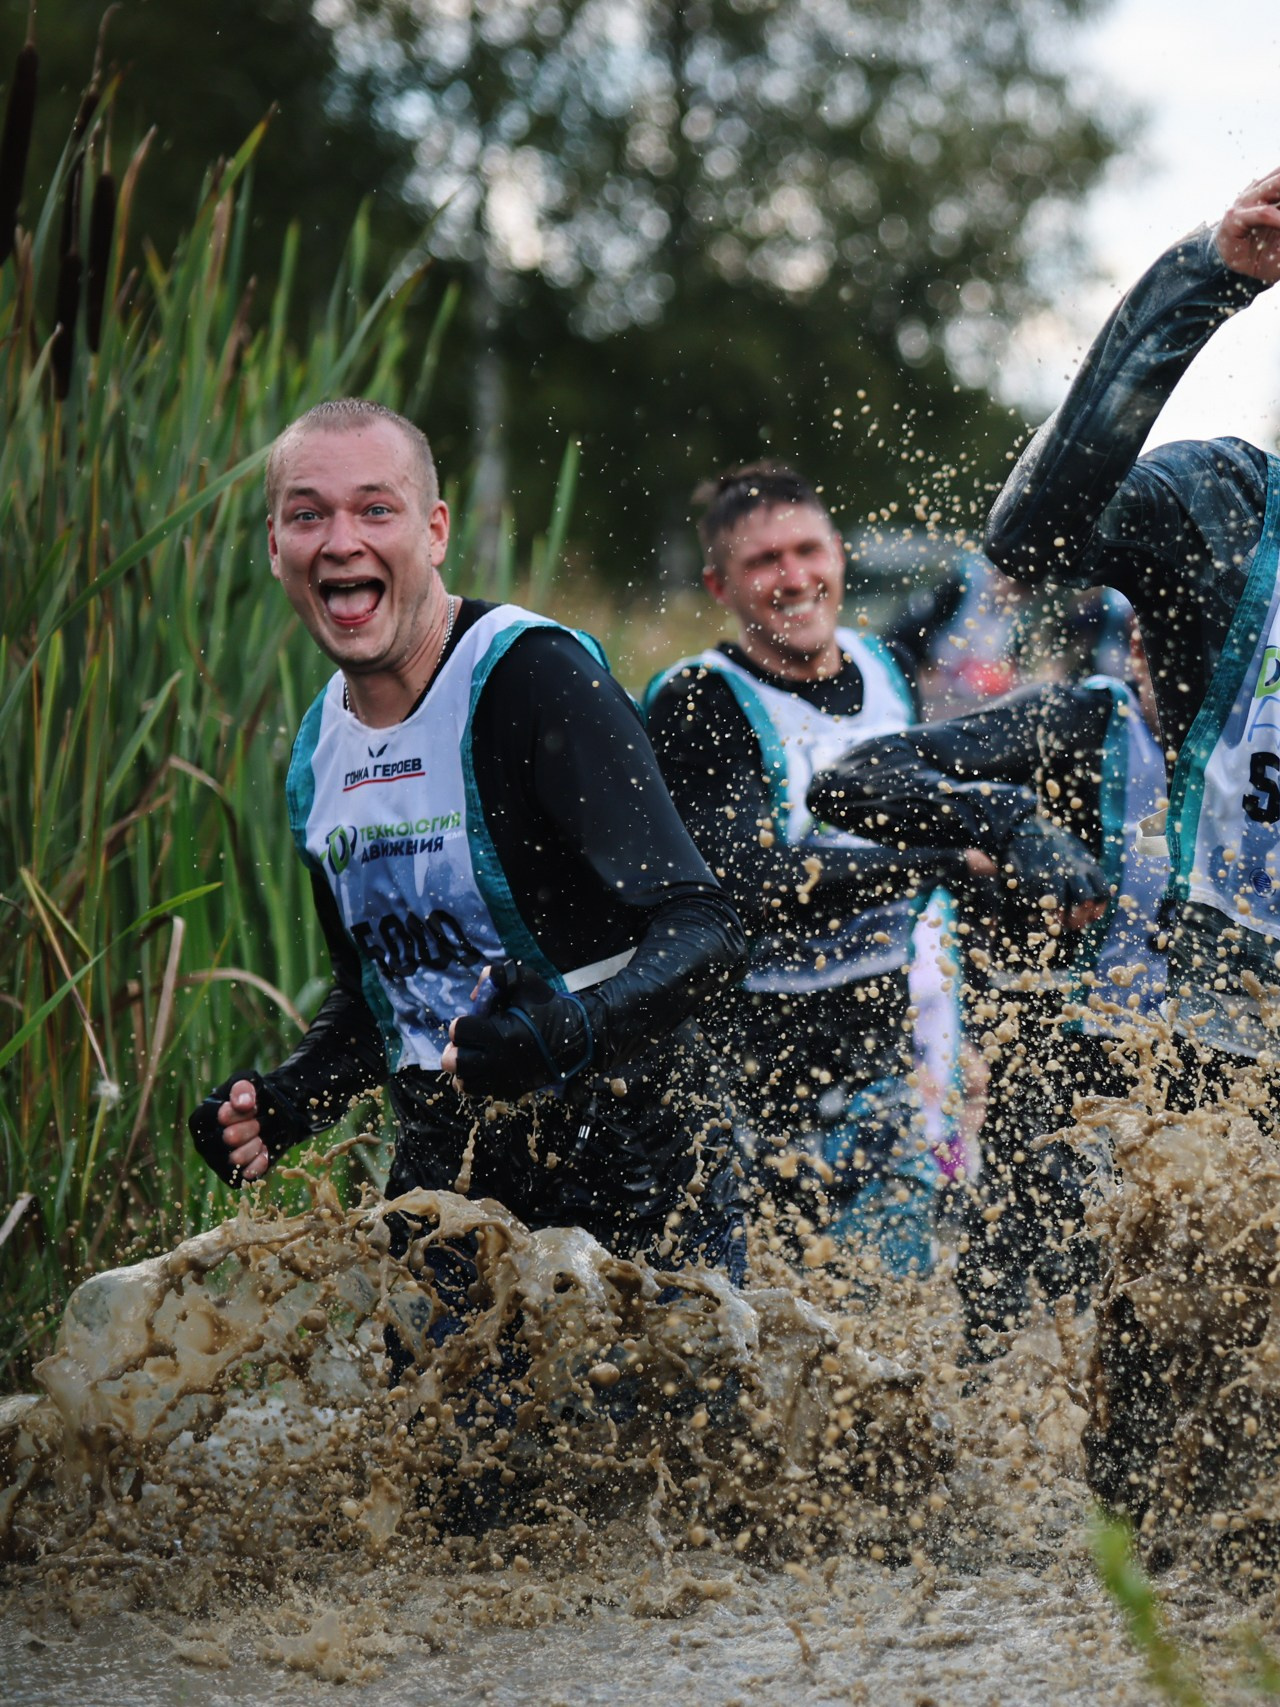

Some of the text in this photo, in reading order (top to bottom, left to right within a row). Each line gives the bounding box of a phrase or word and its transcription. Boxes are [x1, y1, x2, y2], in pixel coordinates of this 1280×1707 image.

[344, 758, 422, 786] ГОНКА ГЕРОЕВ
[360, 811, 461, 842] ТЕХНОЛОГИЯ
[361, 836, 444, 865] ДВИЖЕНИЯ
